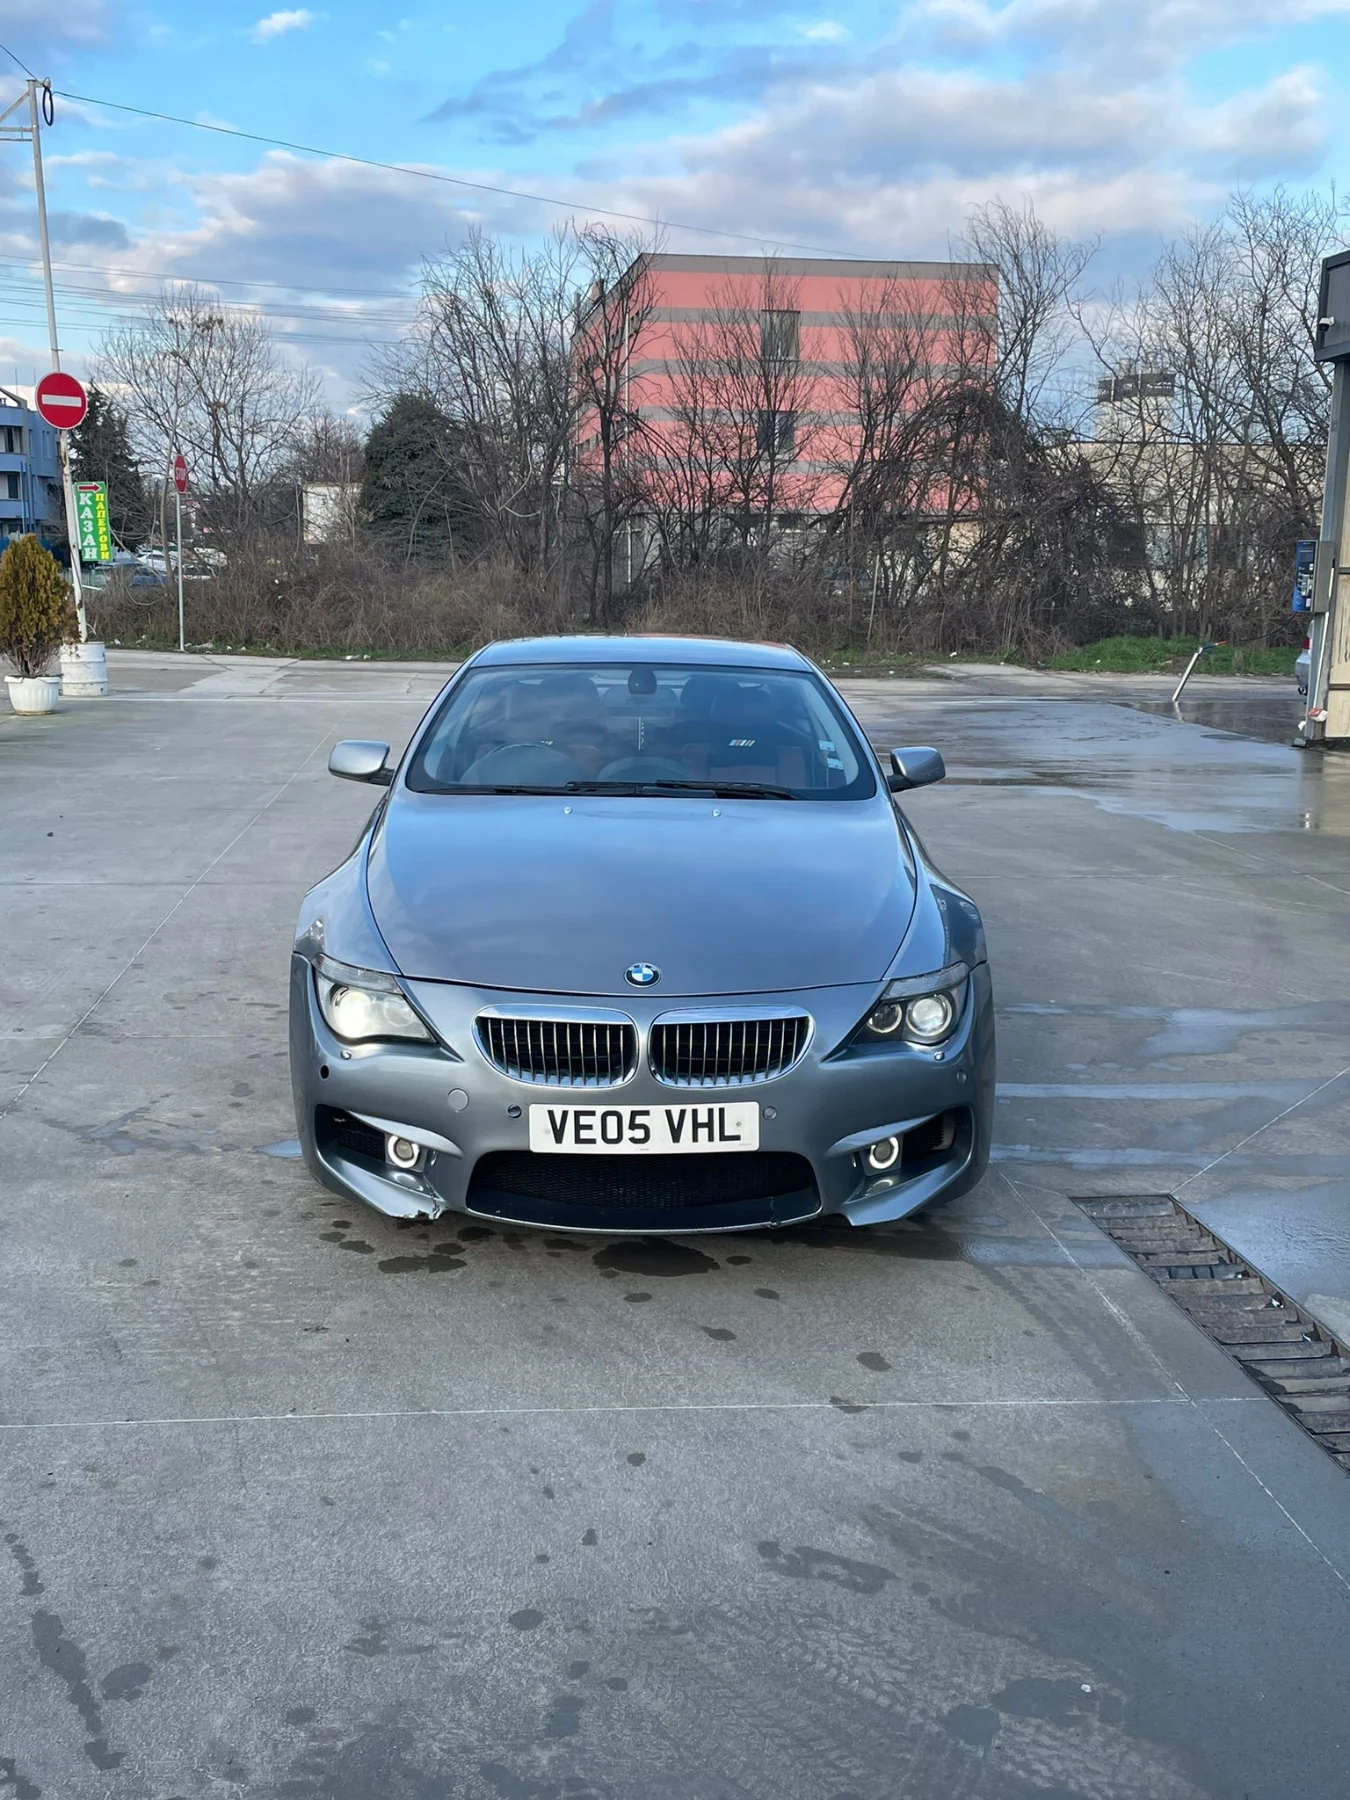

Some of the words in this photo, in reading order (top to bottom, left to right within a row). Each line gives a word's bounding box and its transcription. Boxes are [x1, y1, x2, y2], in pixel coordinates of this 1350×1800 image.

[175, 466, 187, 481] STOP
[79, 493, 98, 559] КАЗАН
[547, 1110, 651, 1145] VE05
[665, 1107, 742, 1144] VHL
